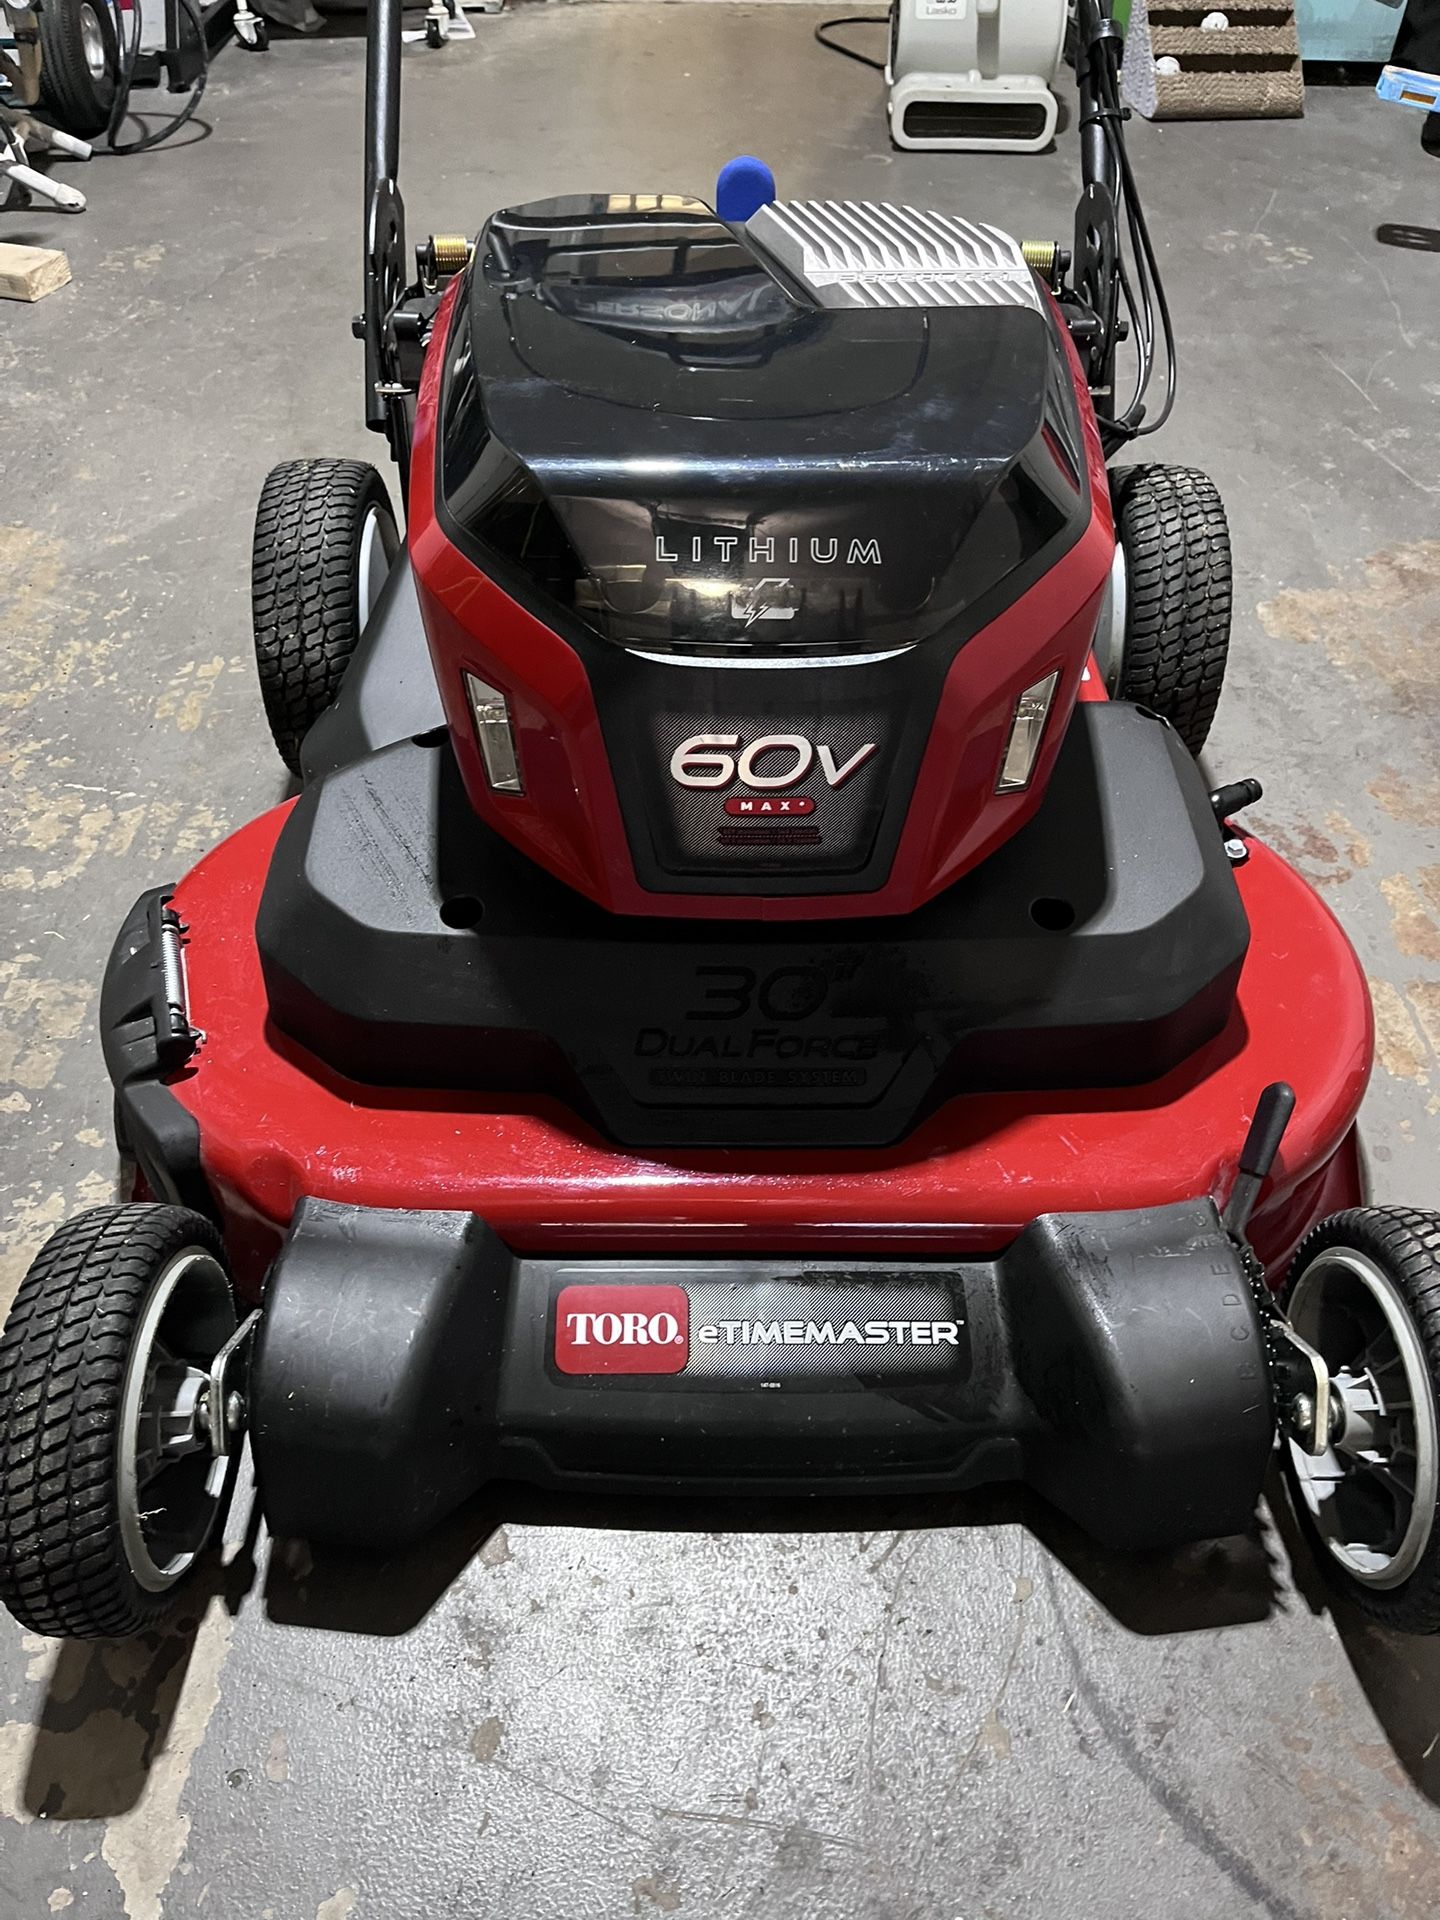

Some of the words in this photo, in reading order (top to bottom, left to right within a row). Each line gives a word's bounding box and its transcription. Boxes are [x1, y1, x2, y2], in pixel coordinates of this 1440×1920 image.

[656, 536, 882, 564] LITHIUM
[718, 1070, 774, 1085] BLADE
[787, 1070, 858, 1085] SYSTEM
